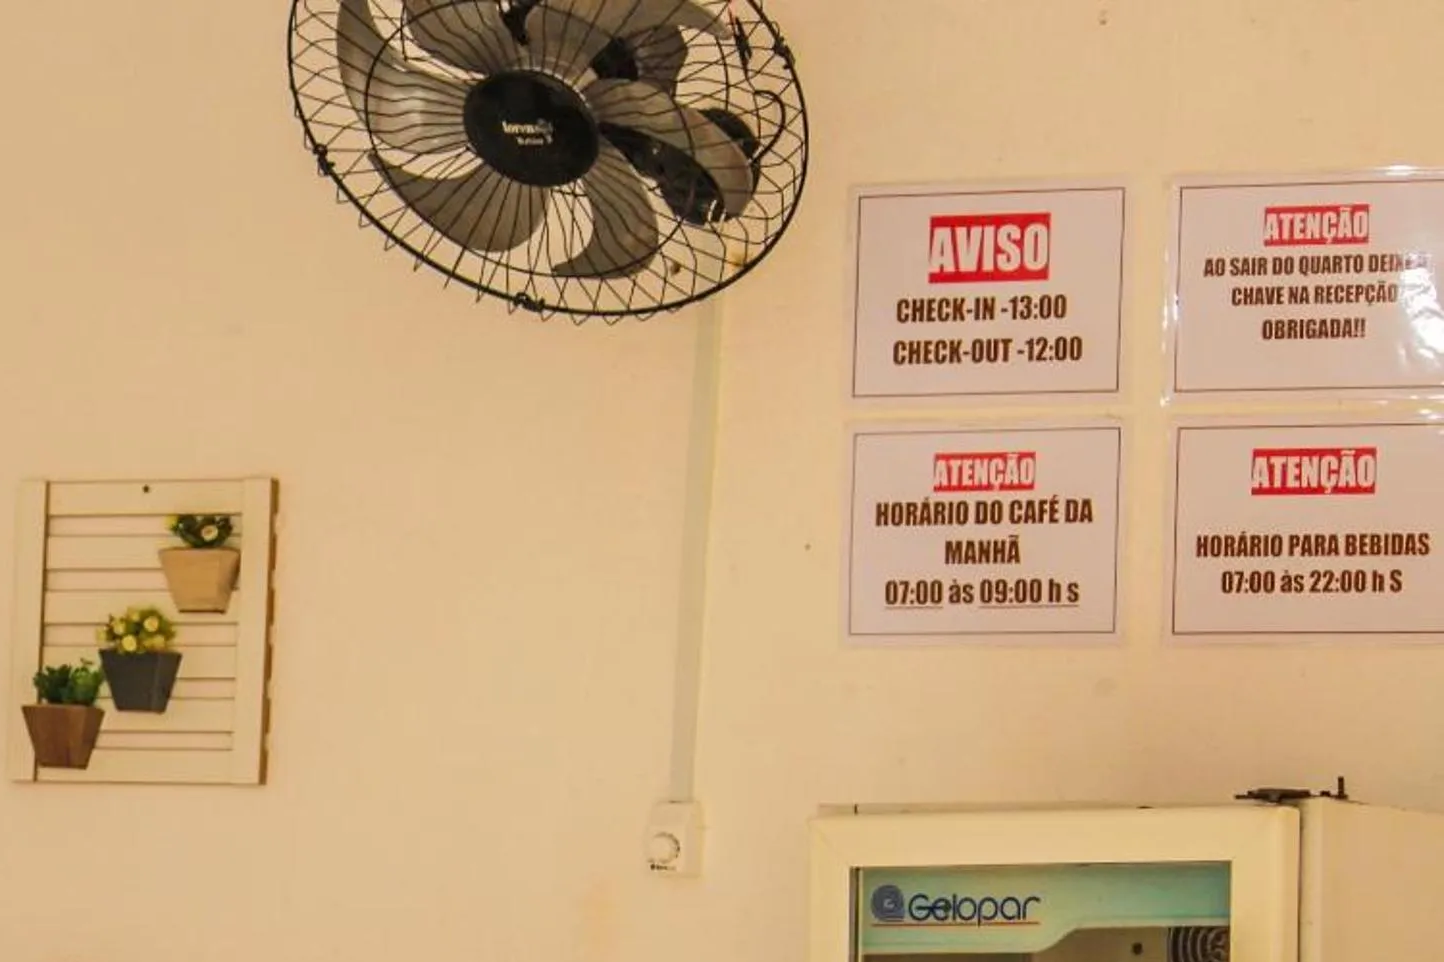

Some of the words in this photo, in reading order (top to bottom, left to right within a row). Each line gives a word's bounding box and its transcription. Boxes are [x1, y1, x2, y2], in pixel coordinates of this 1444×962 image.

[1264, 207, 1369, 244] ATENÇÃO
[928, 222, 1050, 274] AVISO
[1203, 258, 1226, 277] AO
[1229, 257, 1268, 277] SAIR
[1272, 256, 1295, 276] DO
[1298, 253, 1364, 276] QUARTO
[1231, 286, 1284, 306] CHAVE
[1287, 285, 1310, 305] NA
[1314, 280, 1399, 307] RECEPÇÃO
[896, 296, 996, 323] CHECK-IN
[1261, 317, 1366, 341] OBRIGADA!!
[892, 338, 1013, 366] CHECK-OUT
[934, 452, 1036, 491] ATENÇÃO
[1251, 450, 1376, 494] ATENÇÃO
[875, 497, 969, 527] HORÁRIO
[974, 499, 1004, 525] DO
[1008, 494, 1059, 525] CAFÉ
[1064, 498, 1093, 524] DA
[944, 534, 1021, 565] MANHÃ
[1196, 530, 1284, 558] HORÁRIO
[1287, 533, 1340, 558] PARA
[1344, 532, 1430, 557] BEBIDAS
[884, 579, 943, 605] 07:00
[948, 579, 975, 604] às
[979, 578, 1043, 604] 09:00
[1221, 570, 1276, 594] 07:00
[1279, 569, 1305, 594] às
[1309, 569, 1367, 594] 22:00
[907, 892, 1042, 928] Gelopar
